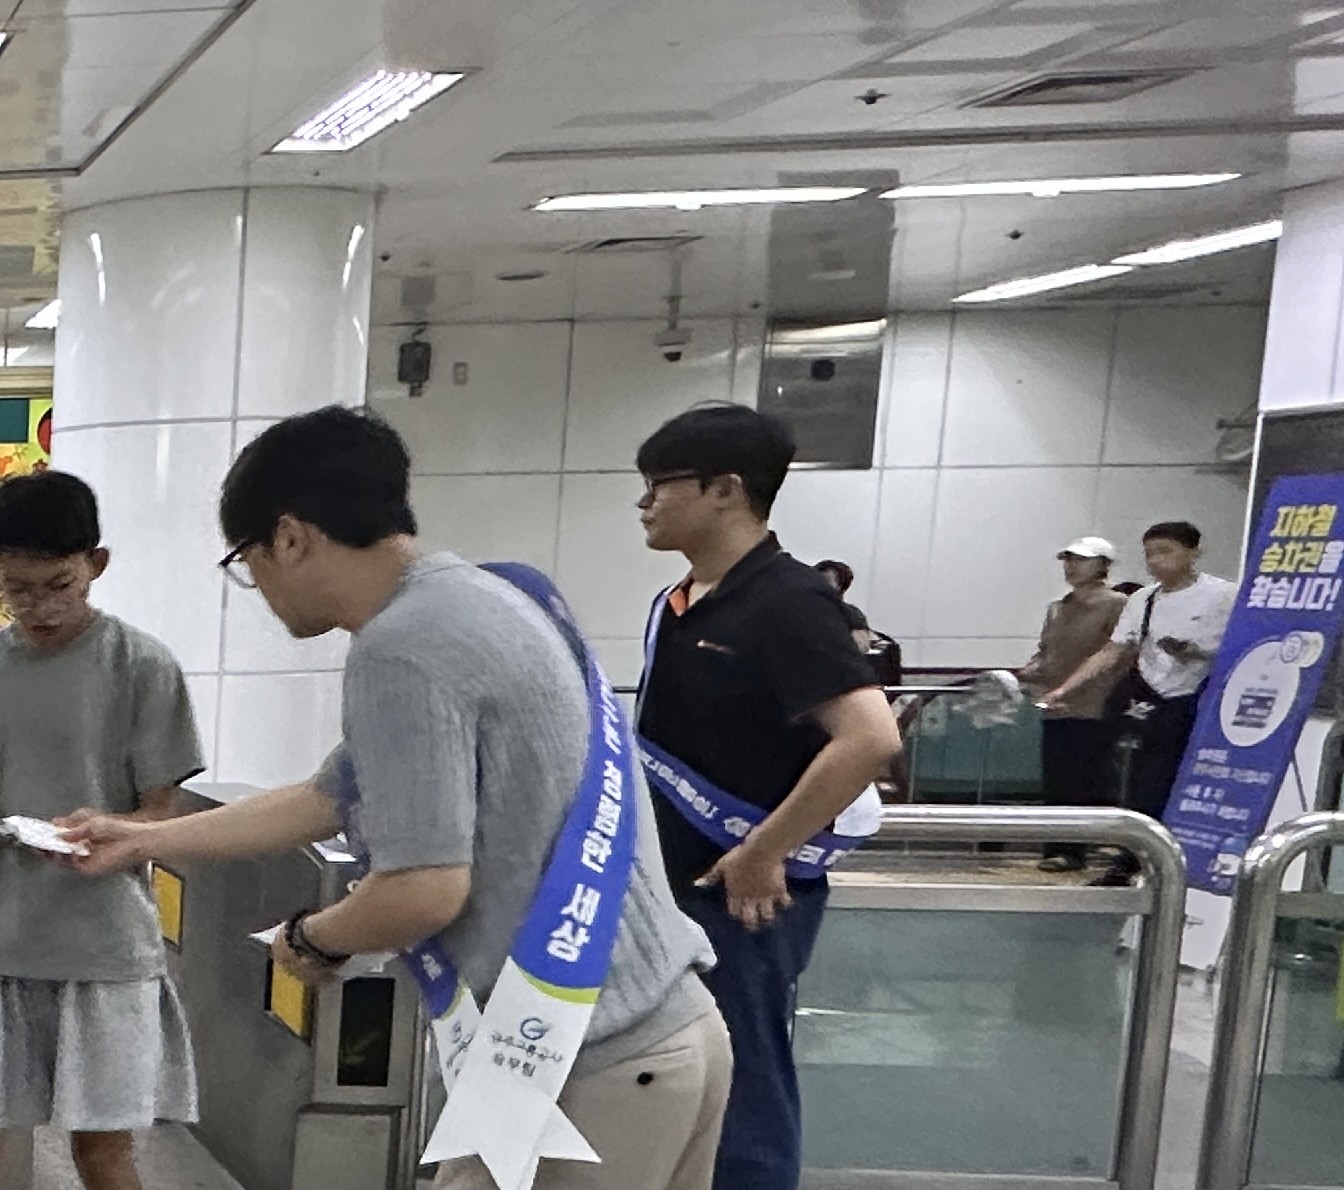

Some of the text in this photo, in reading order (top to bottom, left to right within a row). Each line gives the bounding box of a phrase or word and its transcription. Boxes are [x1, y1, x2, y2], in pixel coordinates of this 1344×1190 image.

[1269, 504, 1337, 537] 지하철
[1259, 541, 1344, 573] 승차권을
[1247, 575, 1342, 611] 찾습니다!
